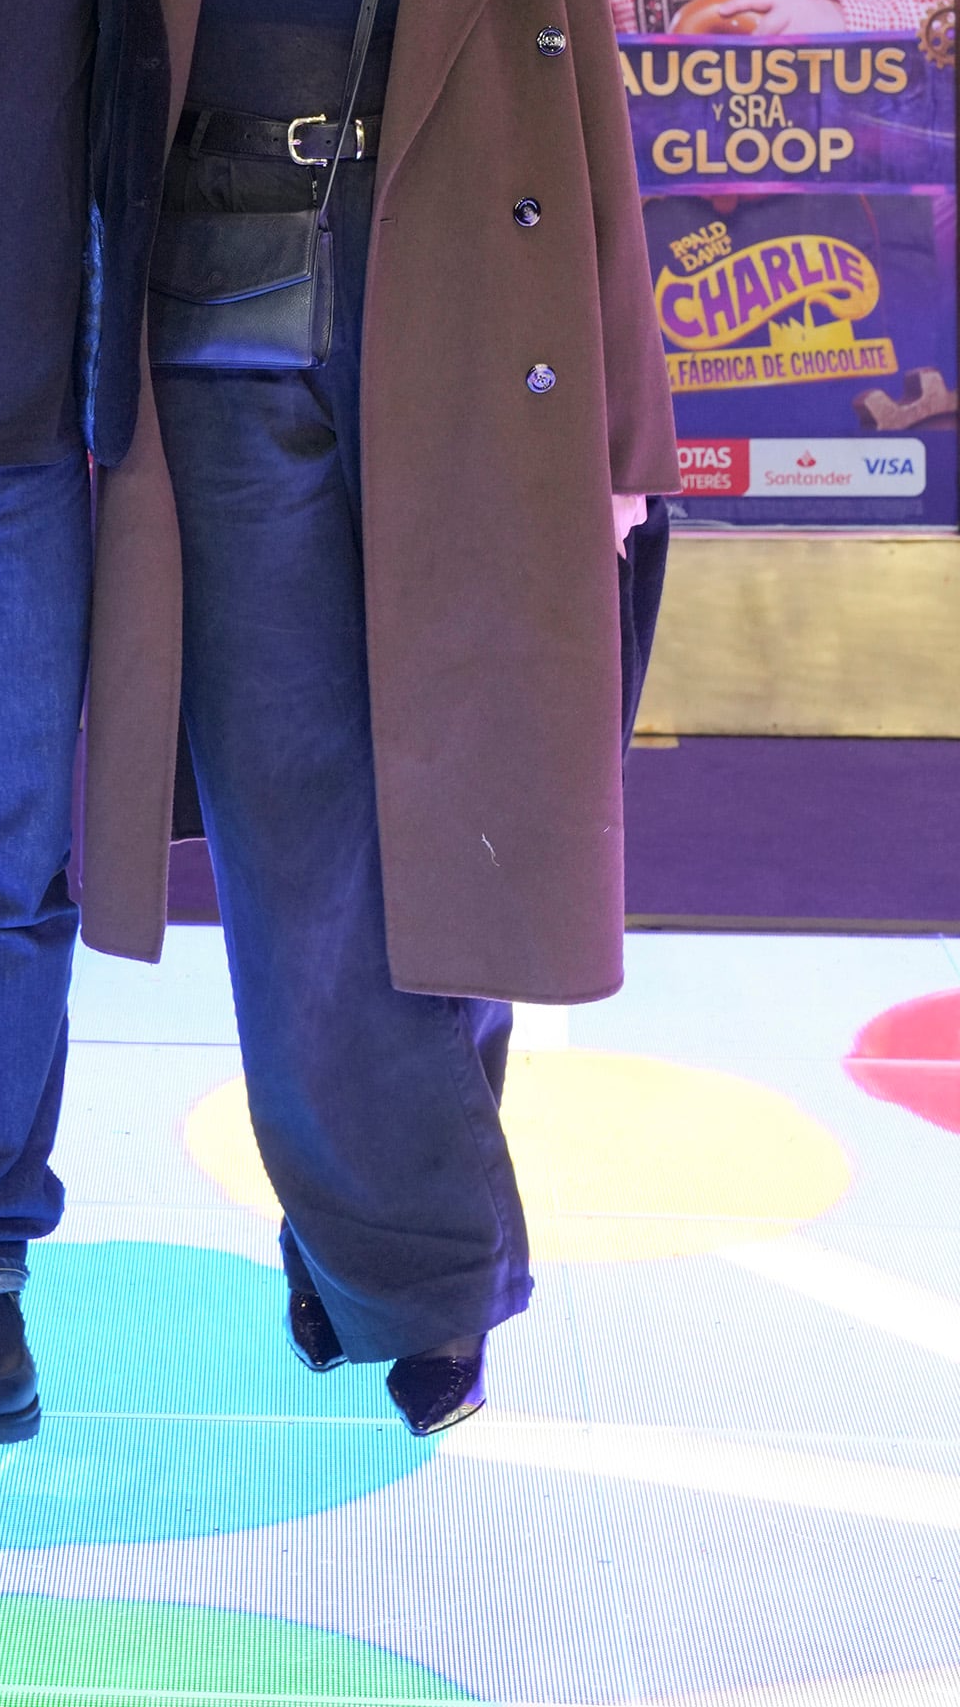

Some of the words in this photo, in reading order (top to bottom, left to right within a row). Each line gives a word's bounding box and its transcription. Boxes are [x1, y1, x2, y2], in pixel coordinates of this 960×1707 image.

[618, 48, 908, 96] AUGUSTUS
[712, 104, 724, 122] Y
[728, 94, 793, 128] SRA.
[652, 127, 854, 175] GLOOP
[661, 242, 865, 339] CHARLIE
[677, 354, 758, 386] FÁBRICA
[762, 353, 787, 379] DE
[791, 346, 888, 376] CHOCOLATE
[765, 470, 852, 487] Santander
[864, 458, 914, 475] VISA
